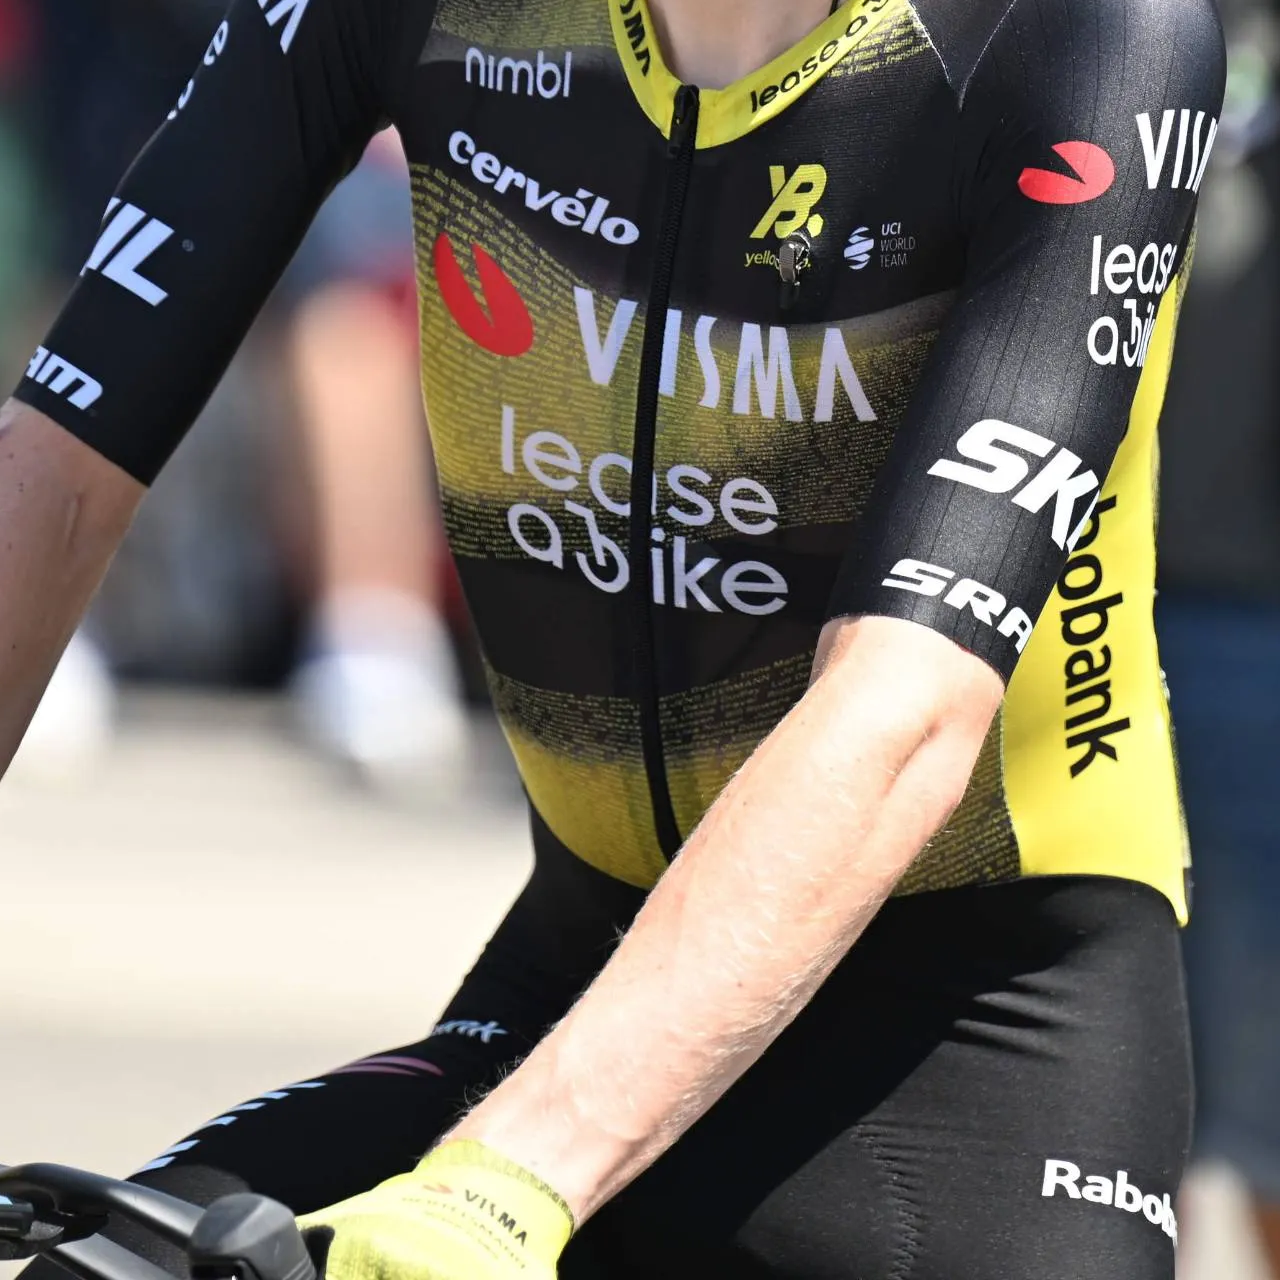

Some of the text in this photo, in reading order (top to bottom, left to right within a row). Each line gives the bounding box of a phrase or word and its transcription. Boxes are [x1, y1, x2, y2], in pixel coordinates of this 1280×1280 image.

[464, 49, 573, 100] nimbl
[750, 39, 839, 113] lease
[845, 15, 868, 38] a
[448, 130, 640, 245] cervélo
[1135, 108, 1218, 195] VIS
[880, 236, 916, 252] WORLD
[880, 252, 907, 268] TEAM
[881, 222, 901, 236] UCI
[572, 285, 878, 422] VISMA
[500, 406, 779, 536] lease
[465, 1188, 528, 1247] VISMA
